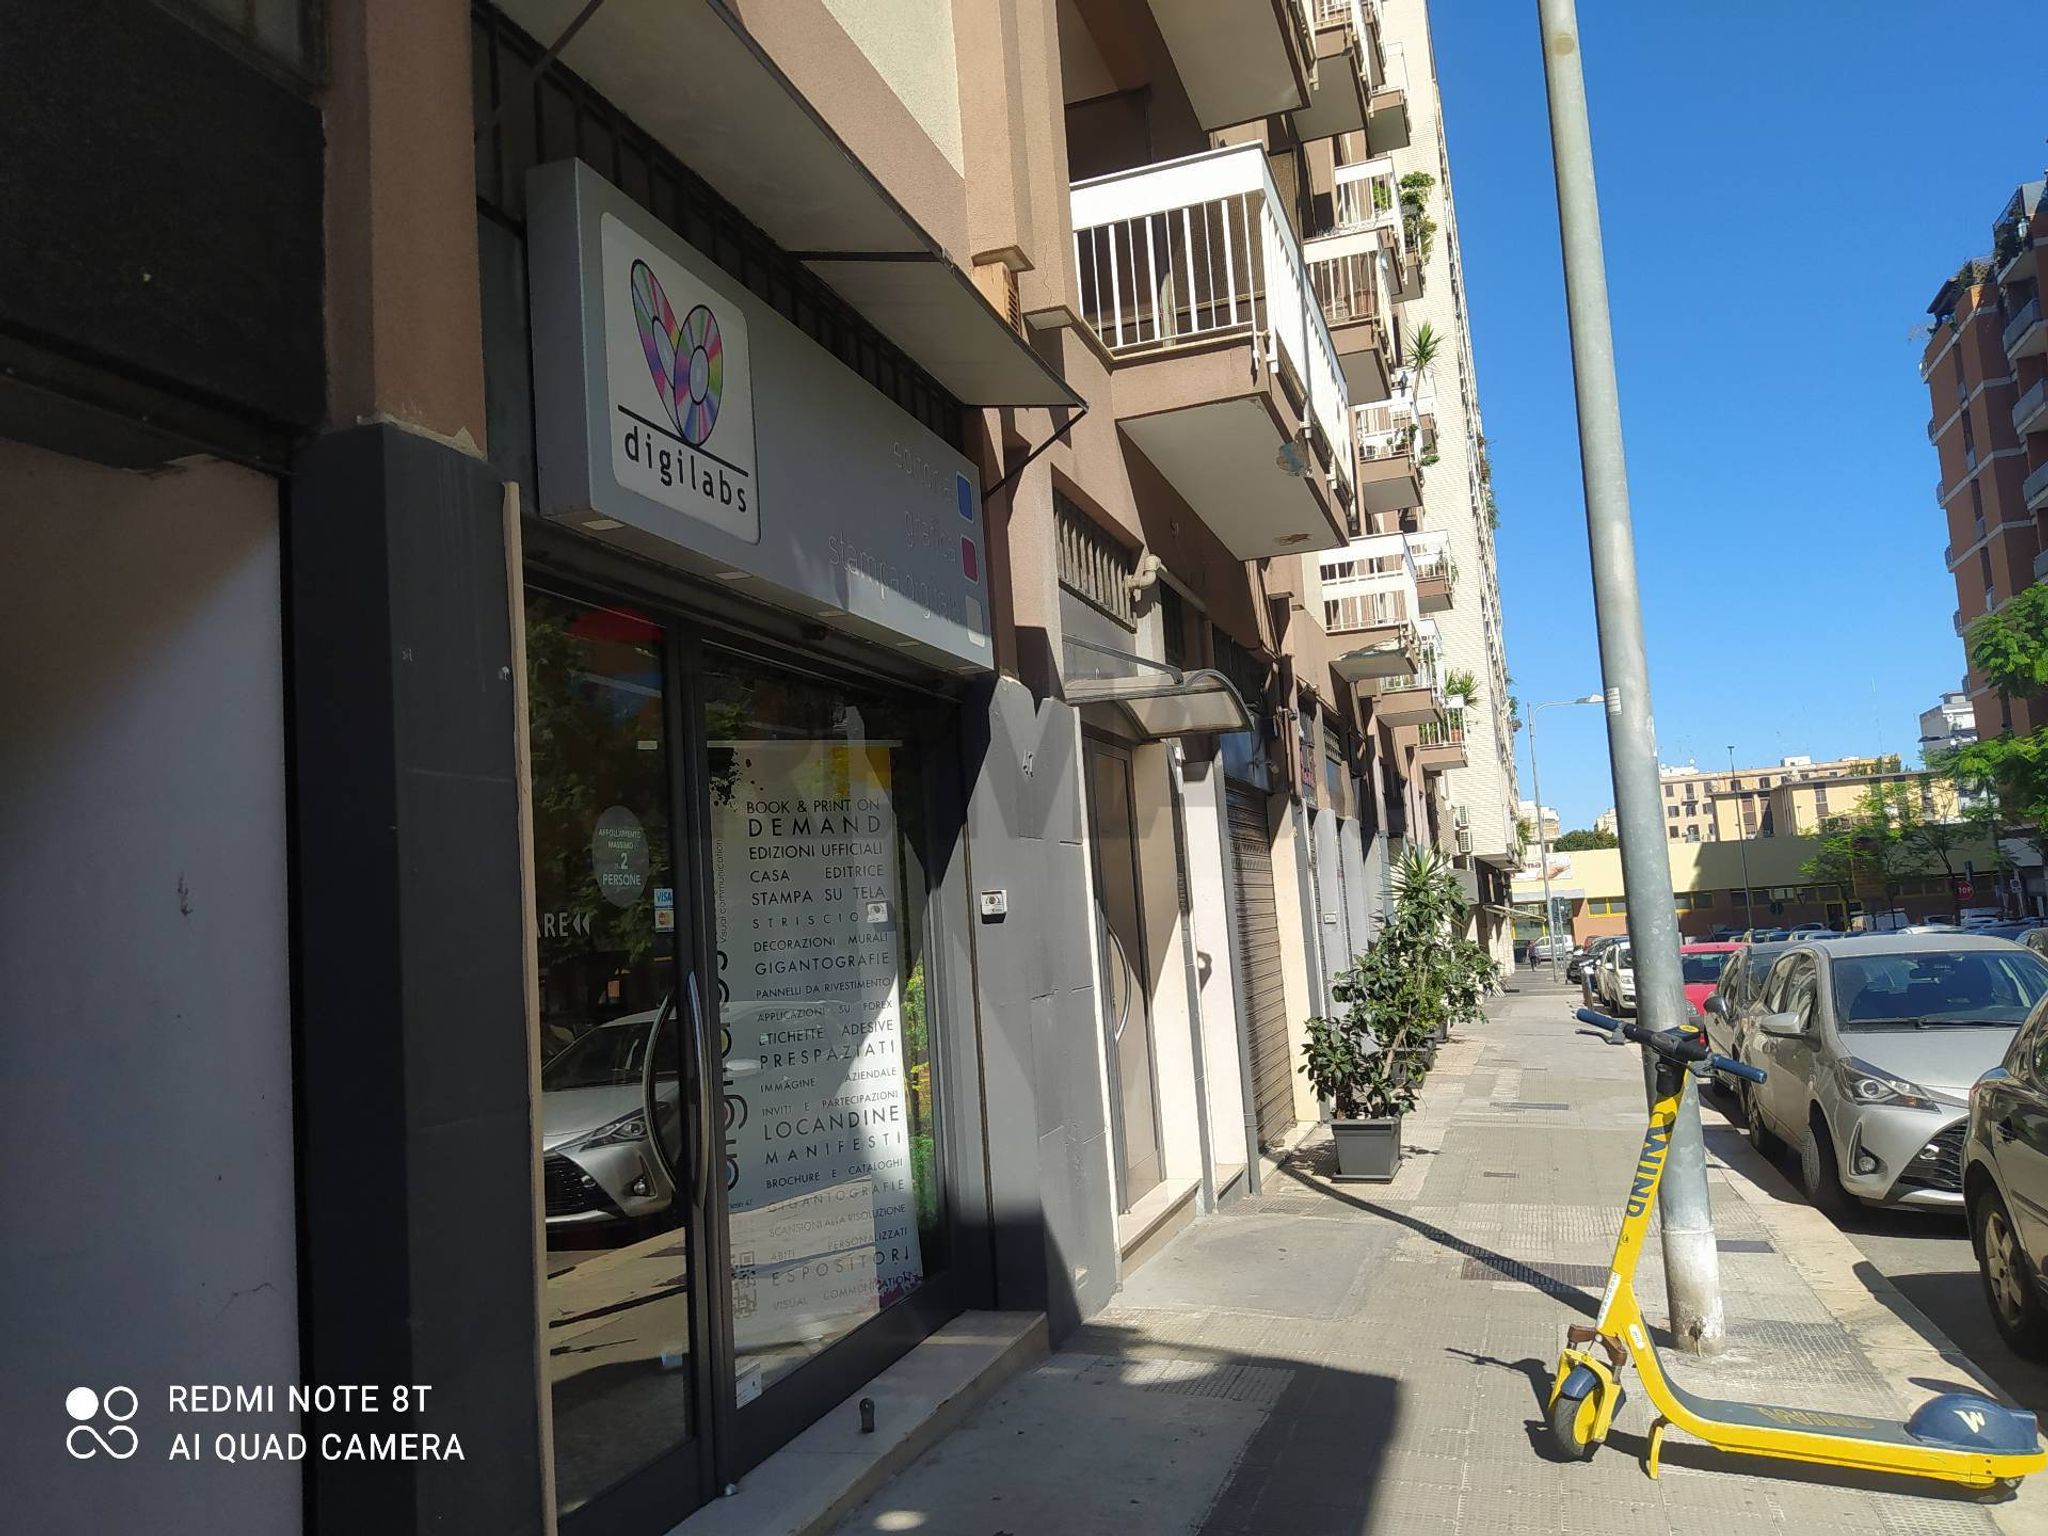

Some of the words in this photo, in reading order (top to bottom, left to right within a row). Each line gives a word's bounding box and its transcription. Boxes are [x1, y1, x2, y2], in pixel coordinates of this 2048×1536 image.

[625, 426, 747, 513] digilabs
[747, 801, 790, 814] BOOK
[797, 801, 808, 813] &
[814, 800, 850, 813] PRINT
[857, 799, 880, 812] ON
[749, 815, 880, 837] DEMAND
[749, 845, 815, 860] EDIZIONI
[822, 842, 882, 857] UFFICIALI
[603, 873, 641, 886] PERSONE
[750, 870, 790, 884] CASA
[825, 865, 885, 880] EDITRICE
[656, 892, 672, 903] VISA
[752, 890, 813, 906] STAMPA
[825, 888, 842, 902] SU
[853, 887, 885, 900] TELA
[753, 912, 859, 930] STRISCIO
[754, 938, 836, 953] DECORAZIONI
[848, 932, 888, 946] MURALI
[755, 951, 889, 976] GIGANTOGRAFIE
[756, 987, 801, 1000] PANNELLI
[805, 984, 820, 995] DA
[824, 977, 891, 992] RIVESTIMENTO
[757, 1007, 826, 1023] APPLICAZIONI
[839, 1004, 850, 1015] SU
[863, 1000, 893, 1012] FOREX
[759, 1027, 825, 1046] ETICHETTE
[841, 1019, 894, 1037] ADESIVE
[760, 1039, 895, 1070] PRESPAZIATI
[760, 1077, 816, 1094] IMMAGINE
[844, 1066, 897, 1082] AZIENDALE
[762, 1105, 792, 1117] INVITI
[804, 1102, 810, 1112] E
[822, 1090, 899, 1109] PARTECIPAZIONI
[764, 1105, 900, 1141] LOCANDINE
[765, 1131, 901, 1165] MANIFESTI
[766, 1171, 821, 1190] BROCHURE
[831, 1169, 837, 1179] E
[848, 1158, 903, 1176] CATALOGHI
[1627, 1125, 1675, 1217] WIND
[772, 1245, 909, 1286] ESPOSITORI
